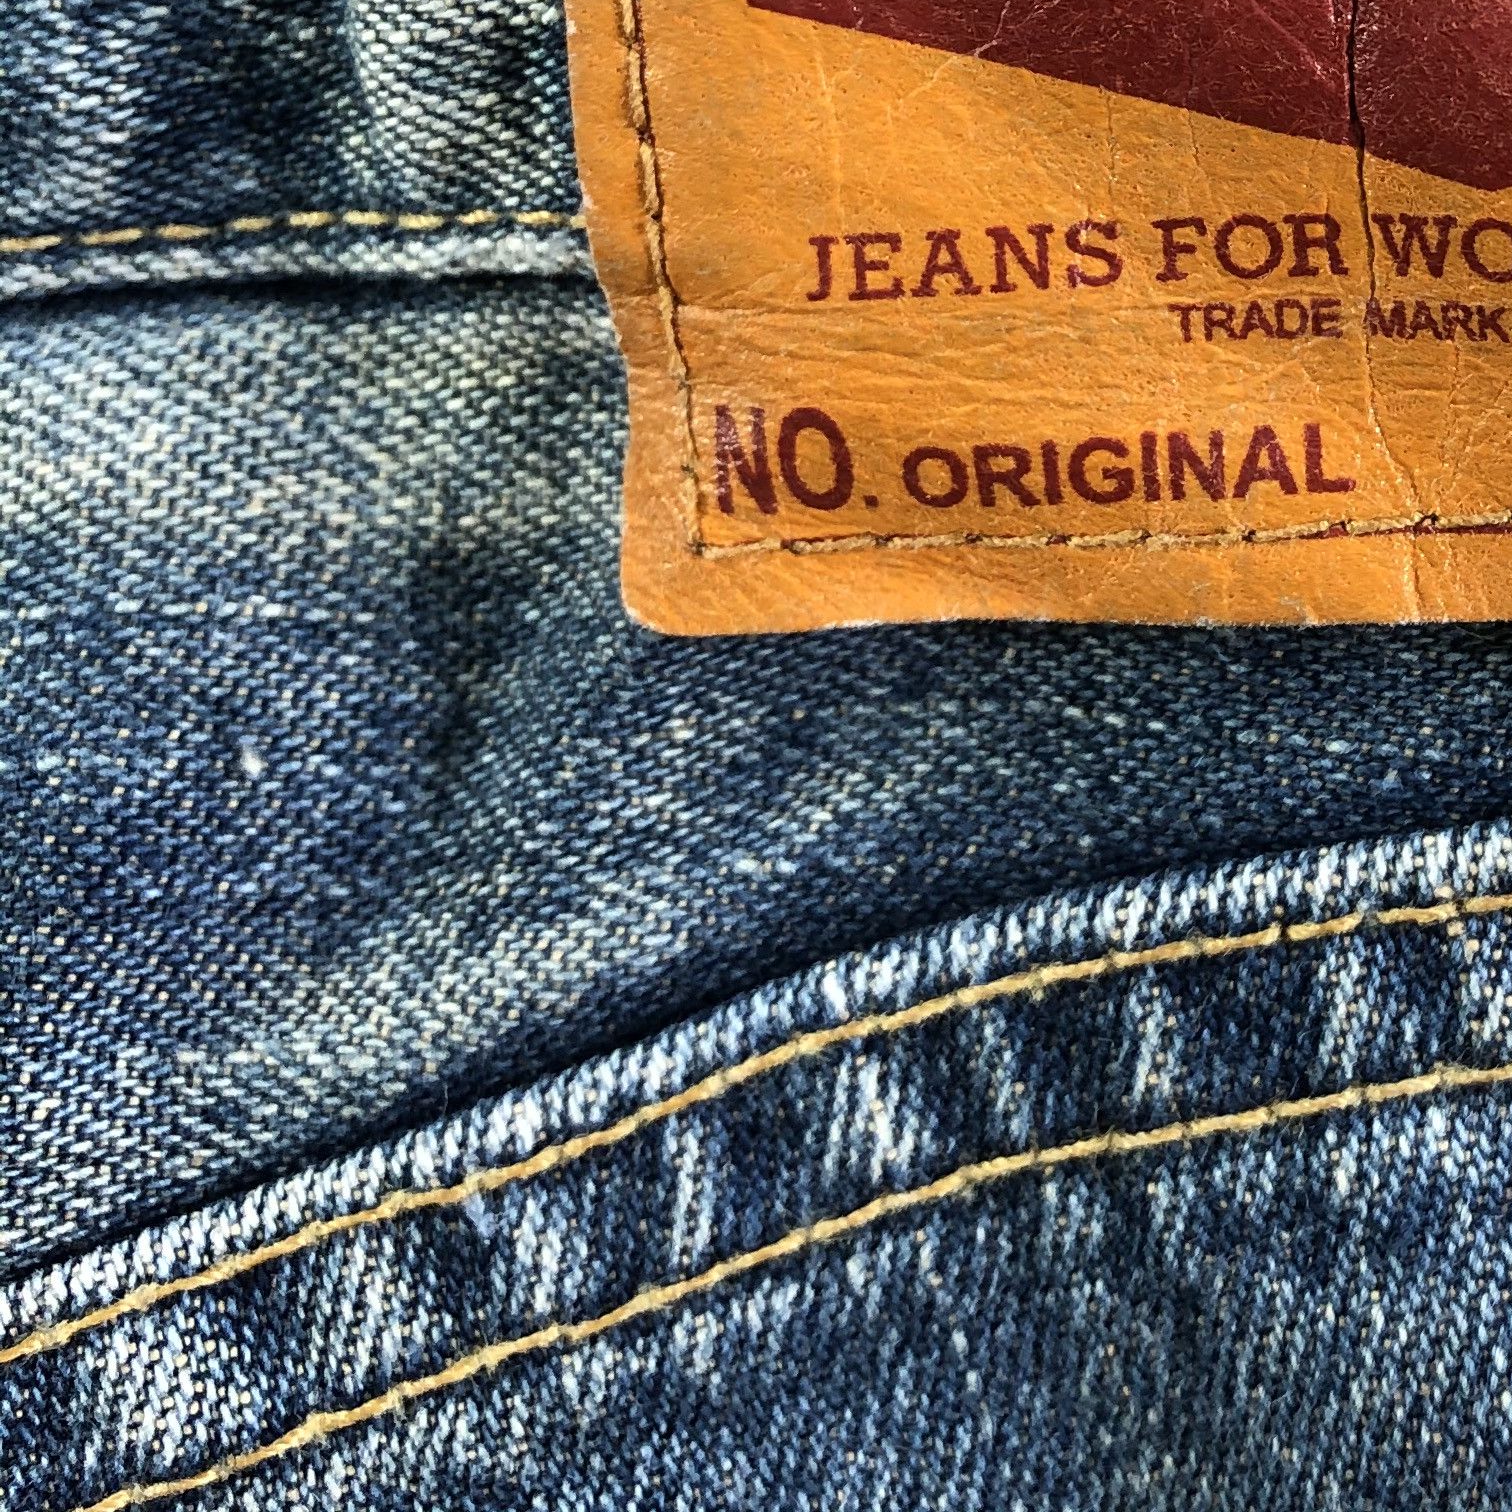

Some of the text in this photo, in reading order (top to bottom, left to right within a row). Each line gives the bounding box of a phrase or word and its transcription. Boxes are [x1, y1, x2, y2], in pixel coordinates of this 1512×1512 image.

[806, 219, 1123, 301] JEANS
[1151, 213, 1350, 281] FOR
[1168, 298, 1343, 343] TRADE
[1363, 299, 1510, 343] MARK
[716, 406, 1356, 515] NO. ORIGINAL
